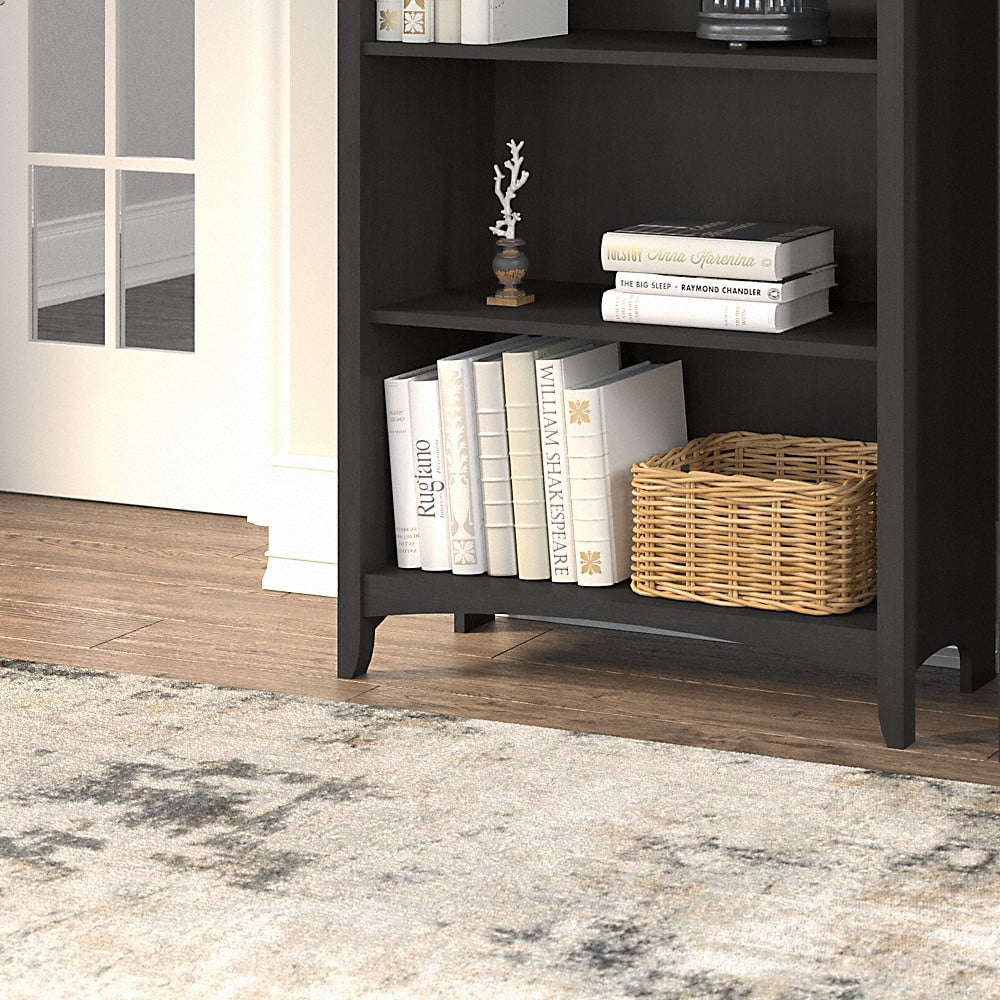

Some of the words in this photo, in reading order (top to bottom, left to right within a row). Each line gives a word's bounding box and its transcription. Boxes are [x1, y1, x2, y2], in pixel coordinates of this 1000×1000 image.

[606, 245, 643, 262] TOLSTOY
[647, 248, 687, 264] Anna
[690, 249, 756, 269] Karenina
[620, 279, 634, 288] THE
[636, 280, 649, 289] BIG
[651, 281, 672, 290] SLEEP
[681, 283, 720, 294] RAYMOND
[722, 286, 762, 297] CHANDLER
[539, 364, 560, 446] WILLIAM
[414, 439, 445, 518] Rugiano
[545, 452, 569, 577] SHAKESPEARE
